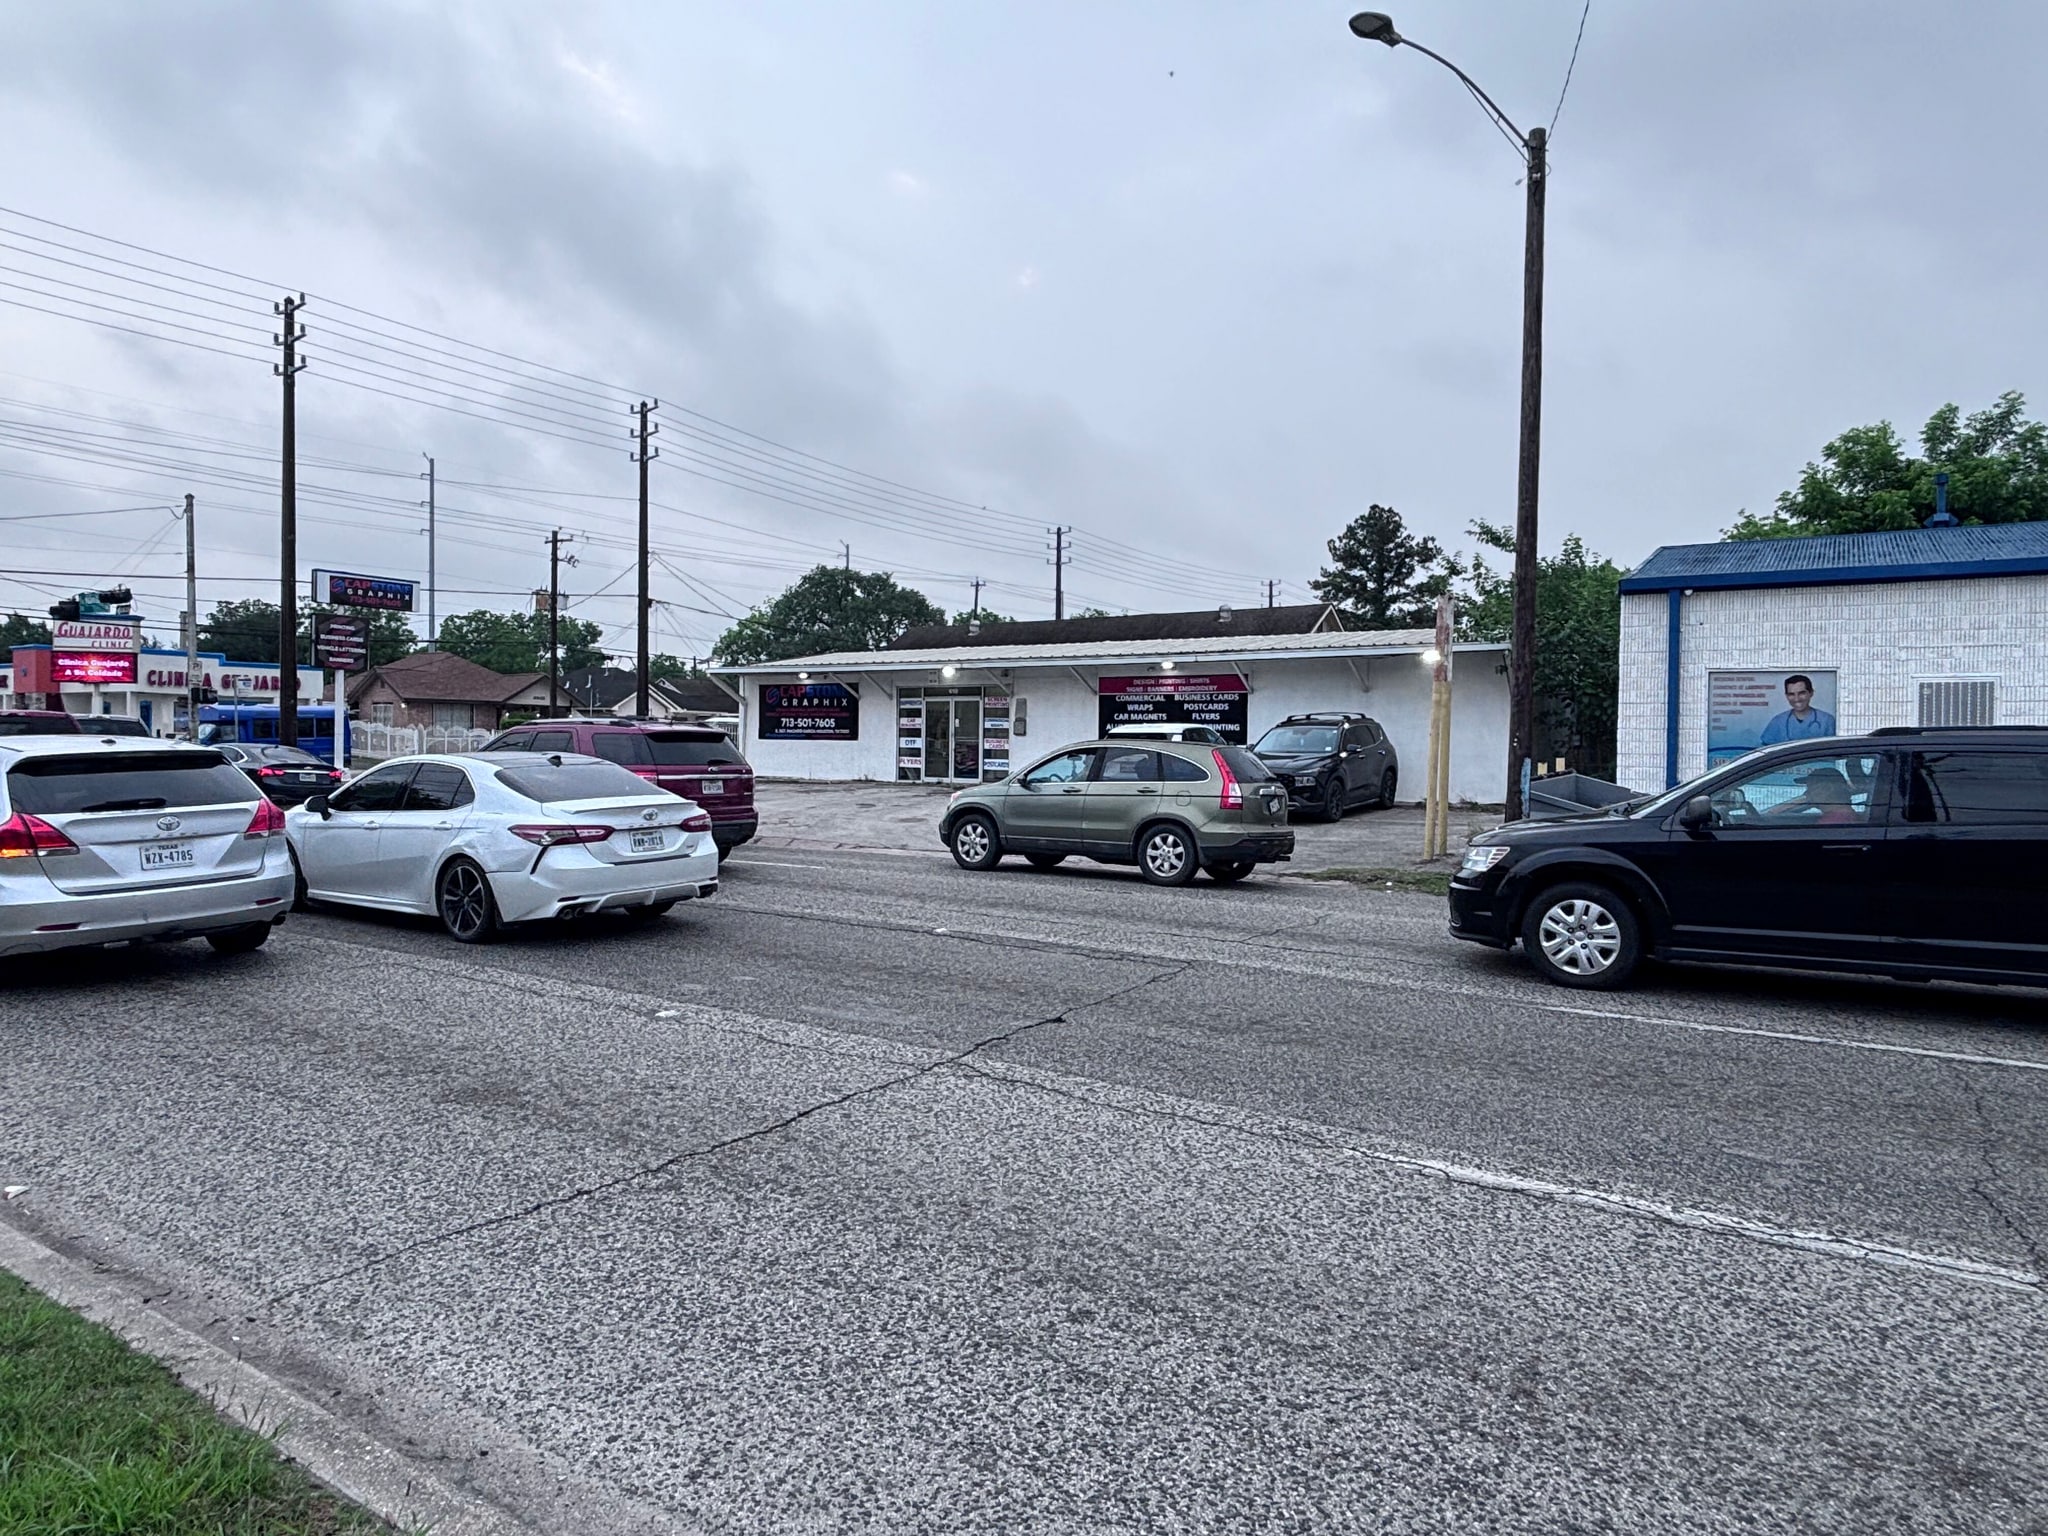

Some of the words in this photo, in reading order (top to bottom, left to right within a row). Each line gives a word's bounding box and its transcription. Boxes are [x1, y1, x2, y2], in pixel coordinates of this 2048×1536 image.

[345, 579, 412, 593] CAPSTONE
[347, 588, 410, 600] GRAPHIX
[58, 621, 131, 639] GUAJARDO
[91, 641, 129, 649] CLINIC
[57, 659, 89, 667] Clinica
[90, 660, 130, 669] Guajardo
[147, 669, 212, 688] CLINIA
[1115, 694, 1166, 702] COMMERCIAL
[1212, 693, 1239, 701] CARDS
[781, 698, 847, 707] GRAPHIX
[1127, 703, 1154, 711] WRAPS
[1183, 703, 1229, 711] POSTCARDS
[1113, 713, 1129, 721] CAR
[1192, 712, 1220, 720] FLYERS
[780, 717, 836, 728] 713-501-7605
[144, 850, 193, 864] WZX-4785
